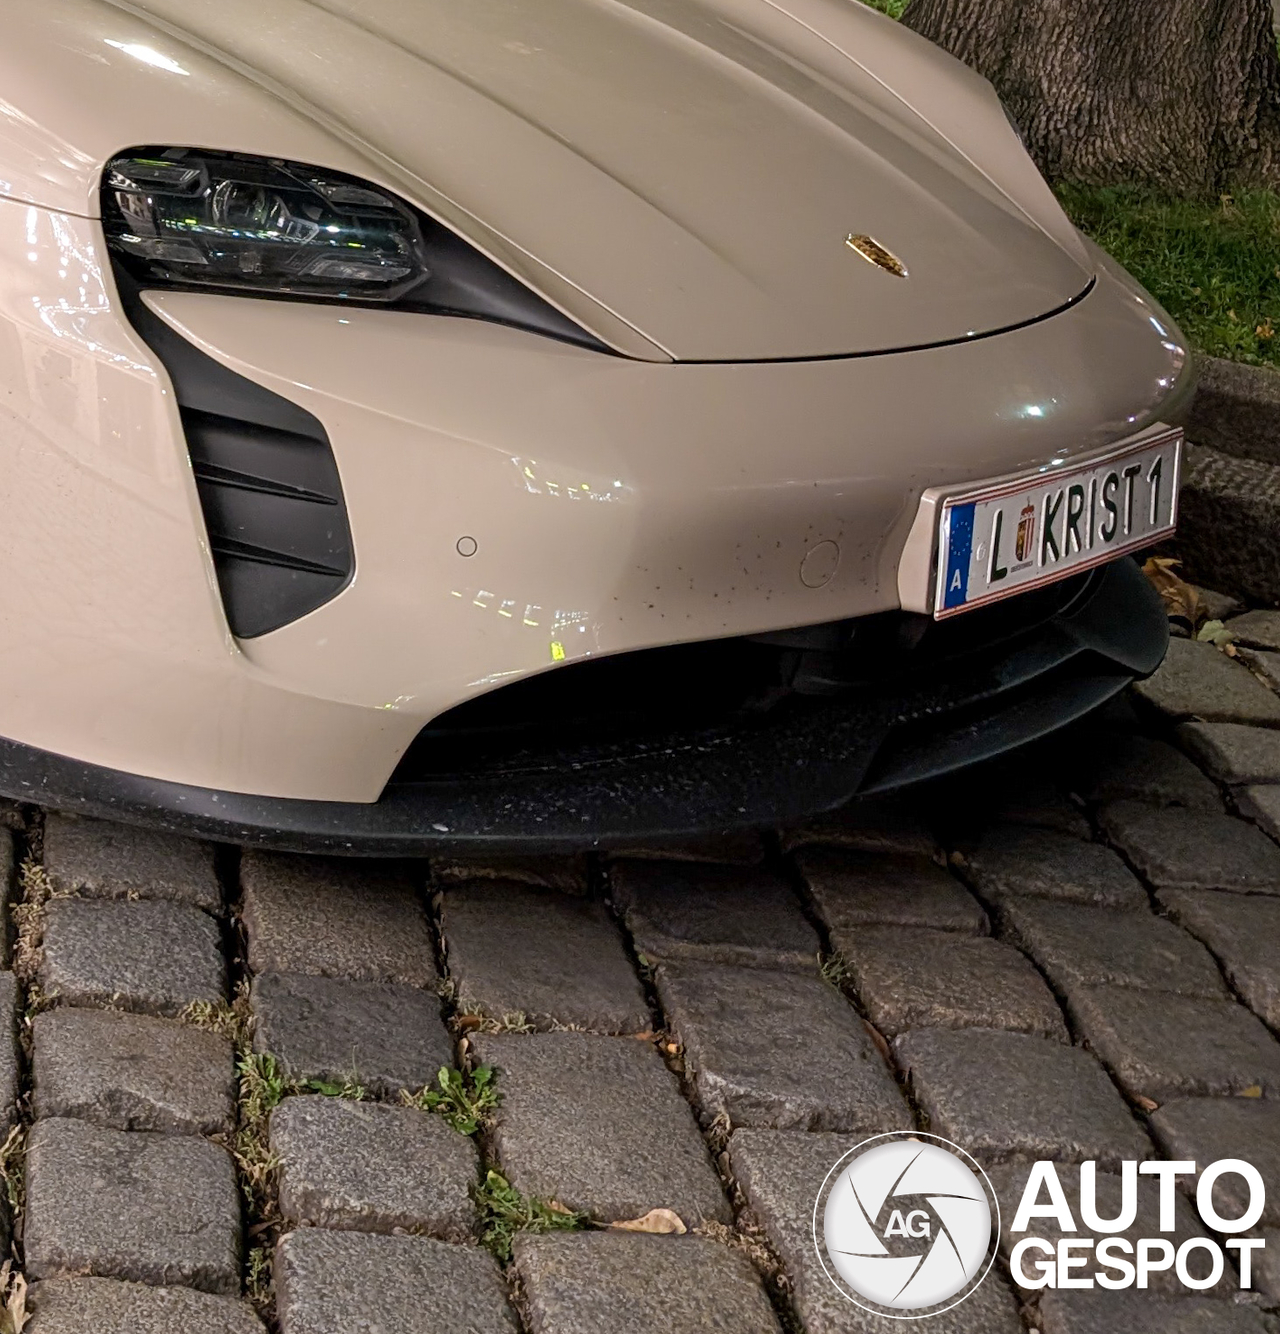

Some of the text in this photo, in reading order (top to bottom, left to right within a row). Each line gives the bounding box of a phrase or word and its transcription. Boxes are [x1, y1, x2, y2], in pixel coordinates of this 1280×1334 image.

[987, 454, 1162, 584] L KRIST 1
[949, 568, 962, 592] A
